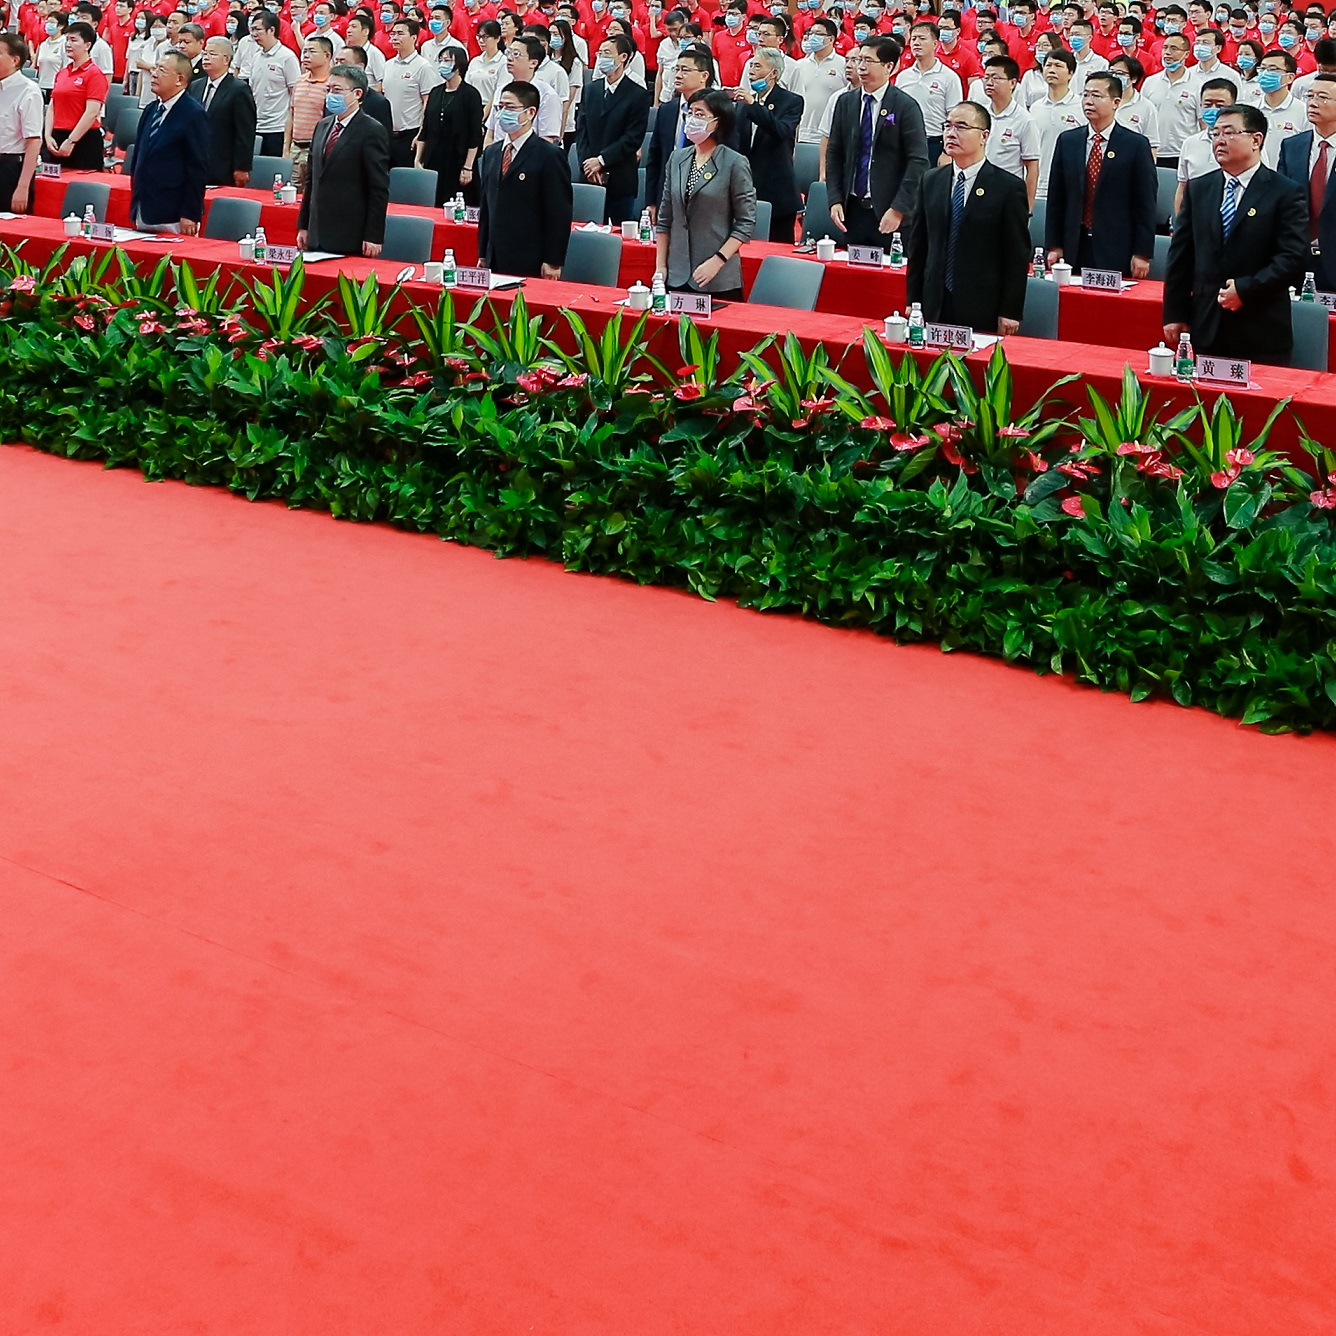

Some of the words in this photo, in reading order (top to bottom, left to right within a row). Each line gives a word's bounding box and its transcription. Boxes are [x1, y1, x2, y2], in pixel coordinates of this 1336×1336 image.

[674, 296, 706, 311] 方琳
[931, 328, 967, 345] 许建领
